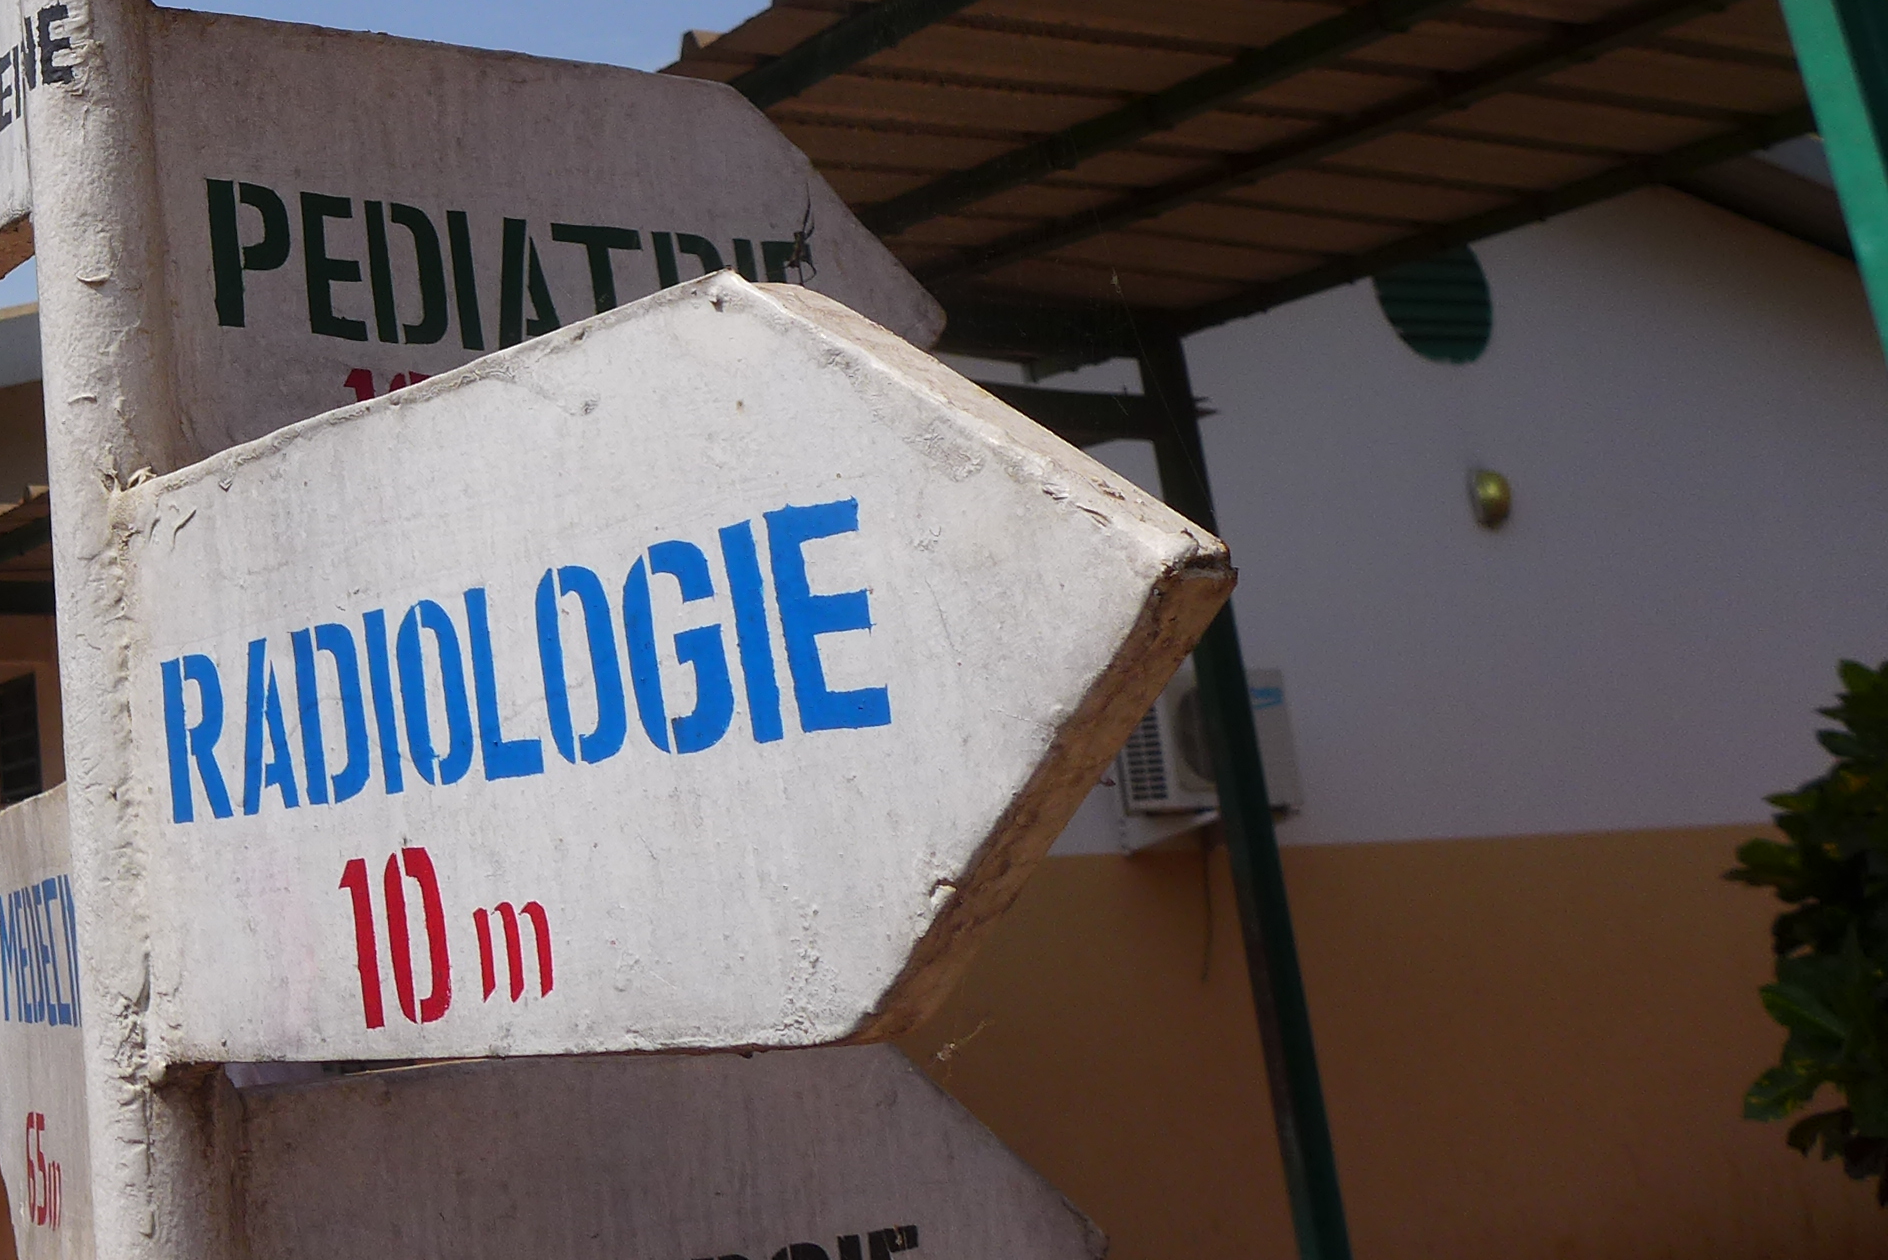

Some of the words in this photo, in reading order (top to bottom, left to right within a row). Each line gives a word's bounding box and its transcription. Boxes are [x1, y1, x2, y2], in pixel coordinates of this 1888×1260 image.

[160, 496, 892, 824] RADIOLOGIE
[338, 846, 453, 1030] 10
[472, 900, 554, 1003] m
